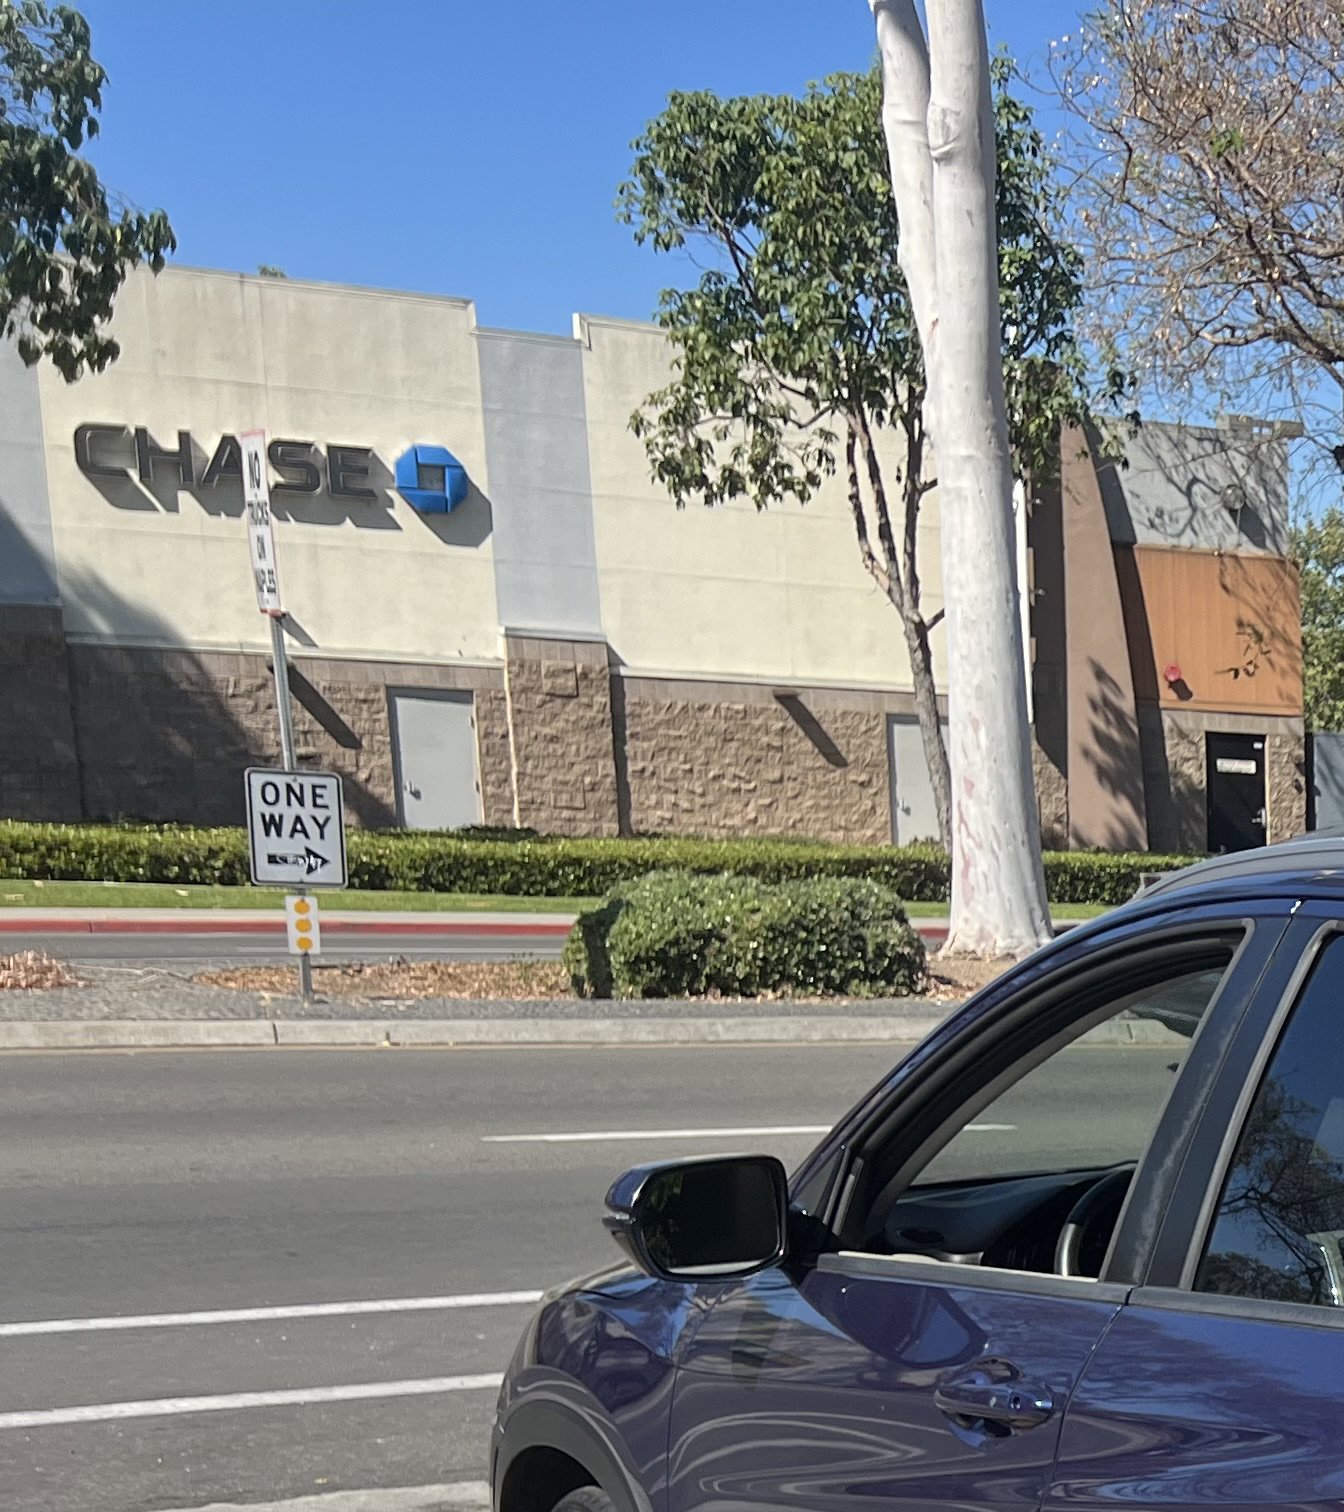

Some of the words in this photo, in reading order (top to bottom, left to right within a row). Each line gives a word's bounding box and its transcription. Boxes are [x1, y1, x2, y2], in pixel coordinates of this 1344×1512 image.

[74, 422, 378, 499] CHASE
[247, 450, 261, 489] NO
[260, 781, 330, 810] ONE
[260, 812, 331, 840] WAY
